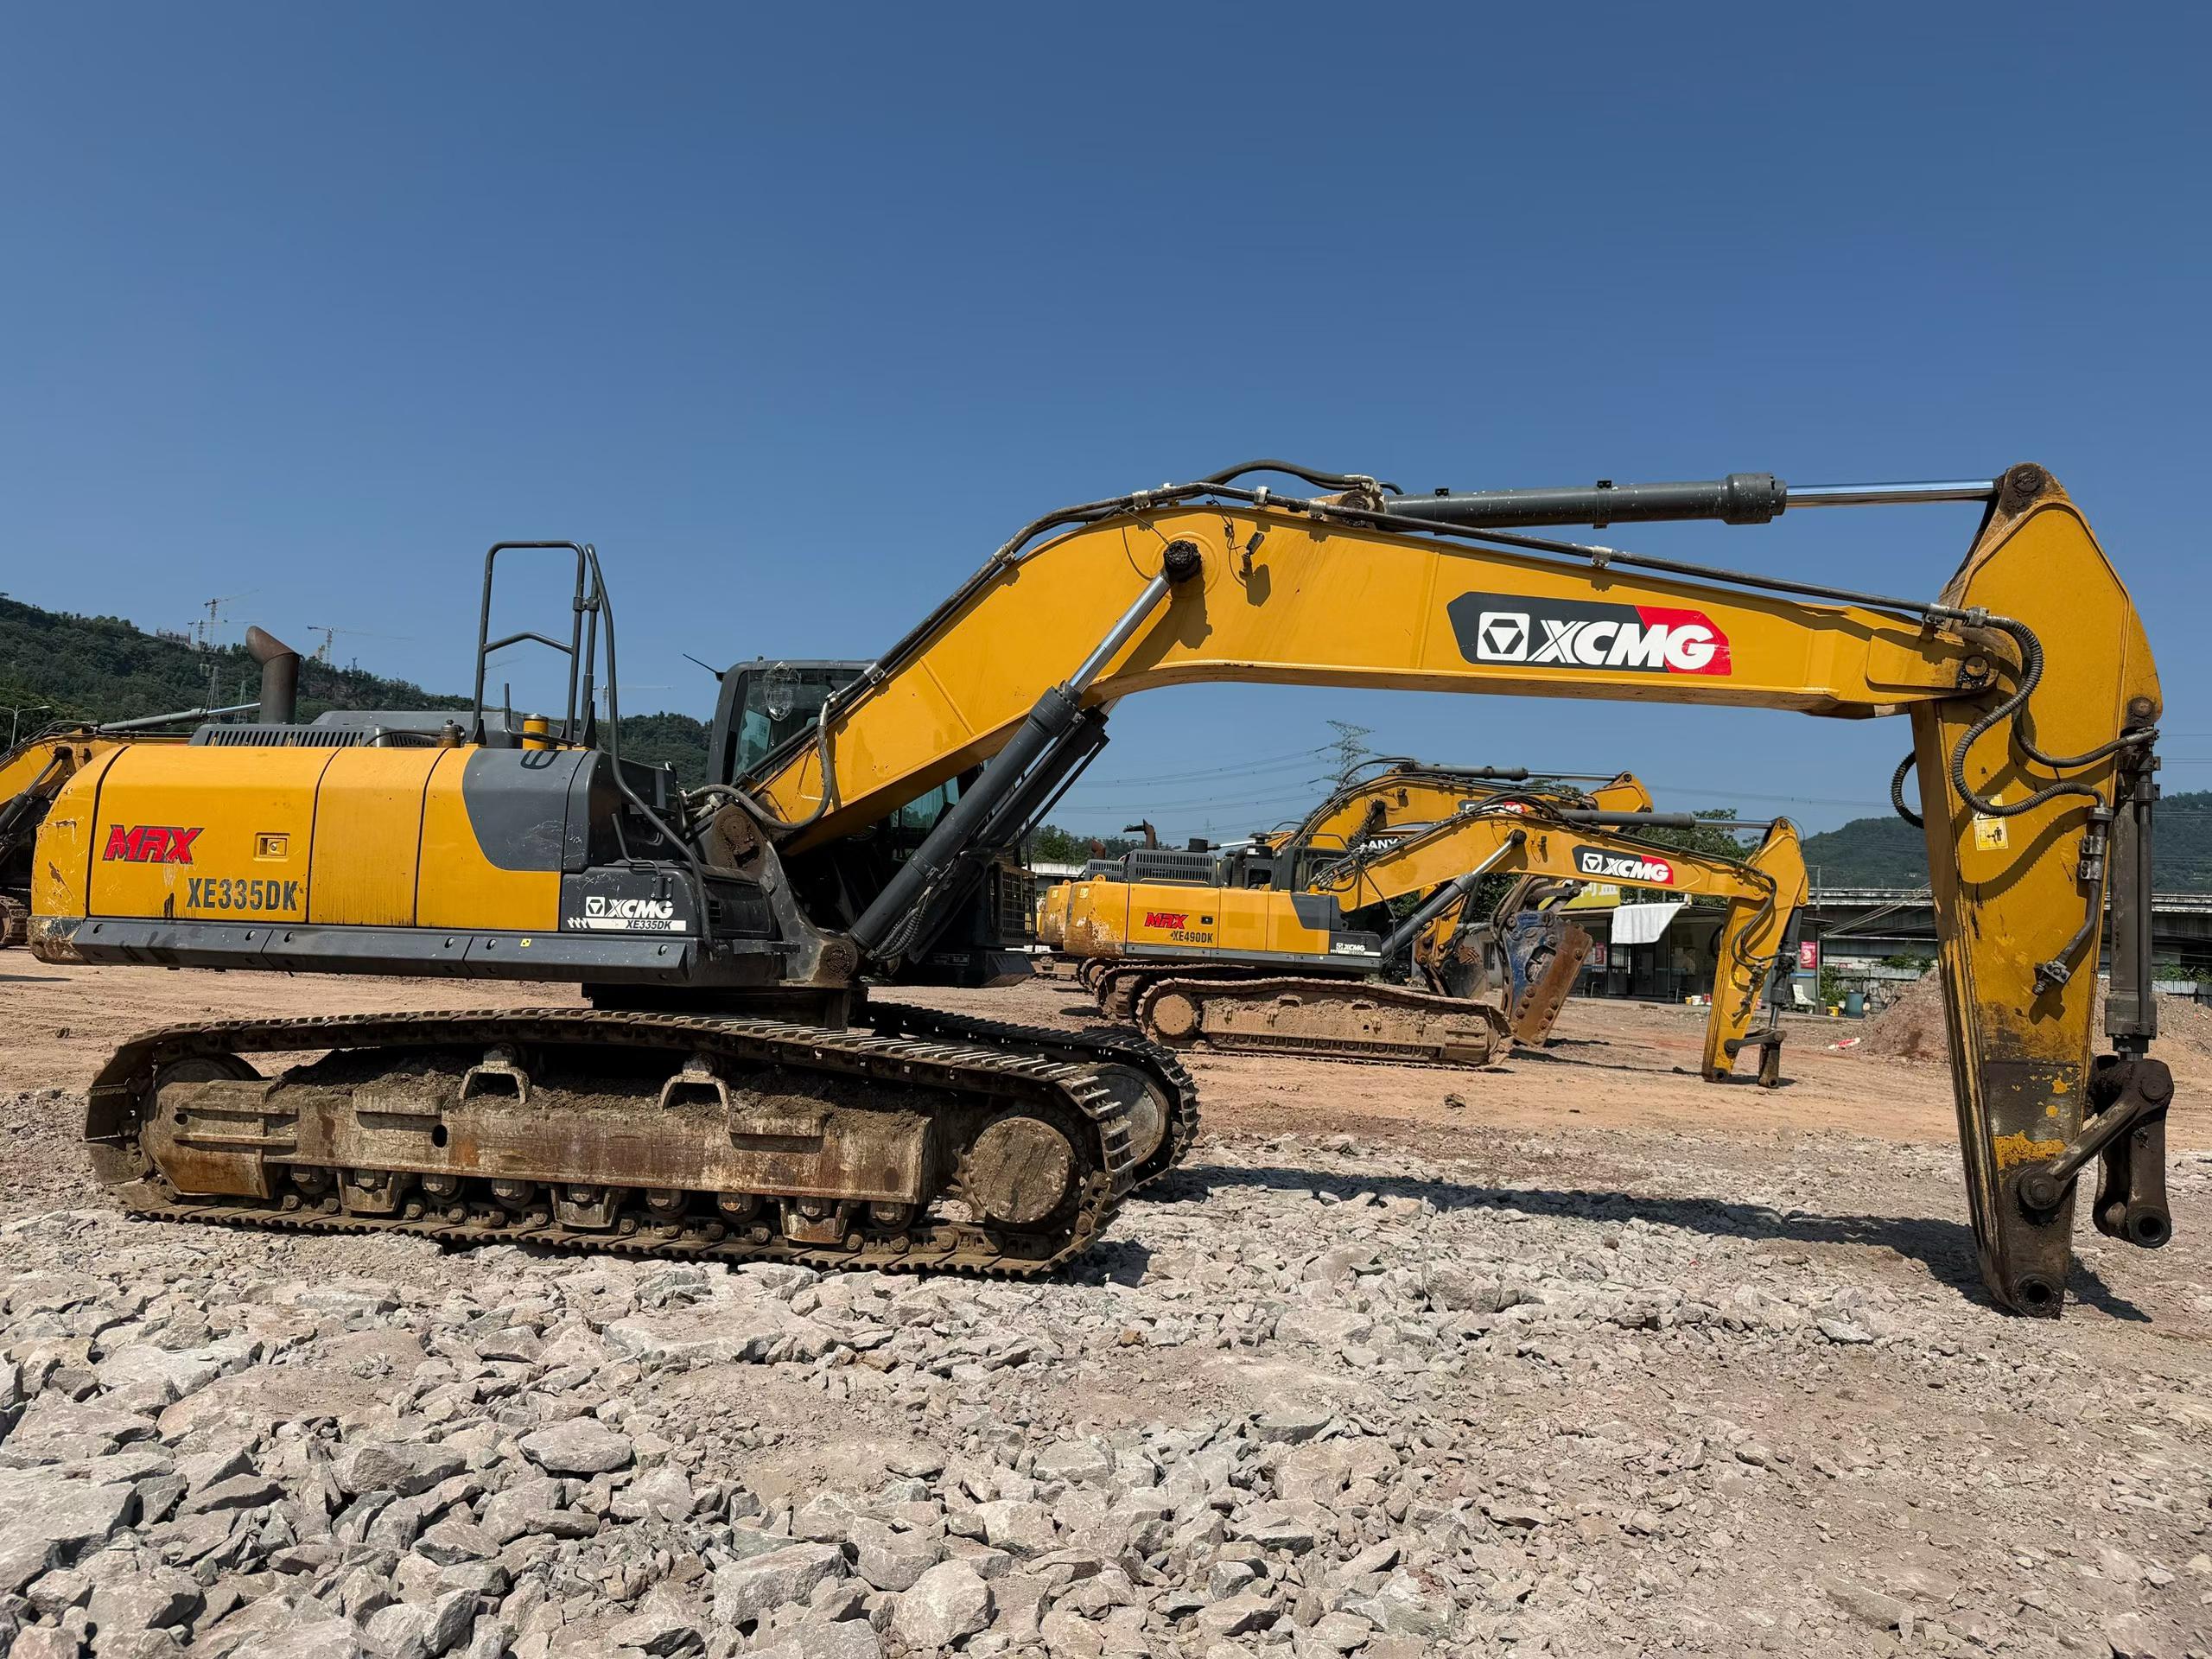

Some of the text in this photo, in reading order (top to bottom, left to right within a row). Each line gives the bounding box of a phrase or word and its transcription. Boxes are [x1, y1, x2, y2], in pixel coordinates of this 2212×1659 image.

[1527, 620, 1715, 670] XCMG
[1368, 838, 1398, 849] ANY
[1601, 857, 1669, 882] XCMG
[186, 877, 298, 912] XE335DK
[605, 899, 674, 918] XCMG
[626, 919, 672, 931] XE335DK
[1173, 931, 1213, 944] XE490DK
